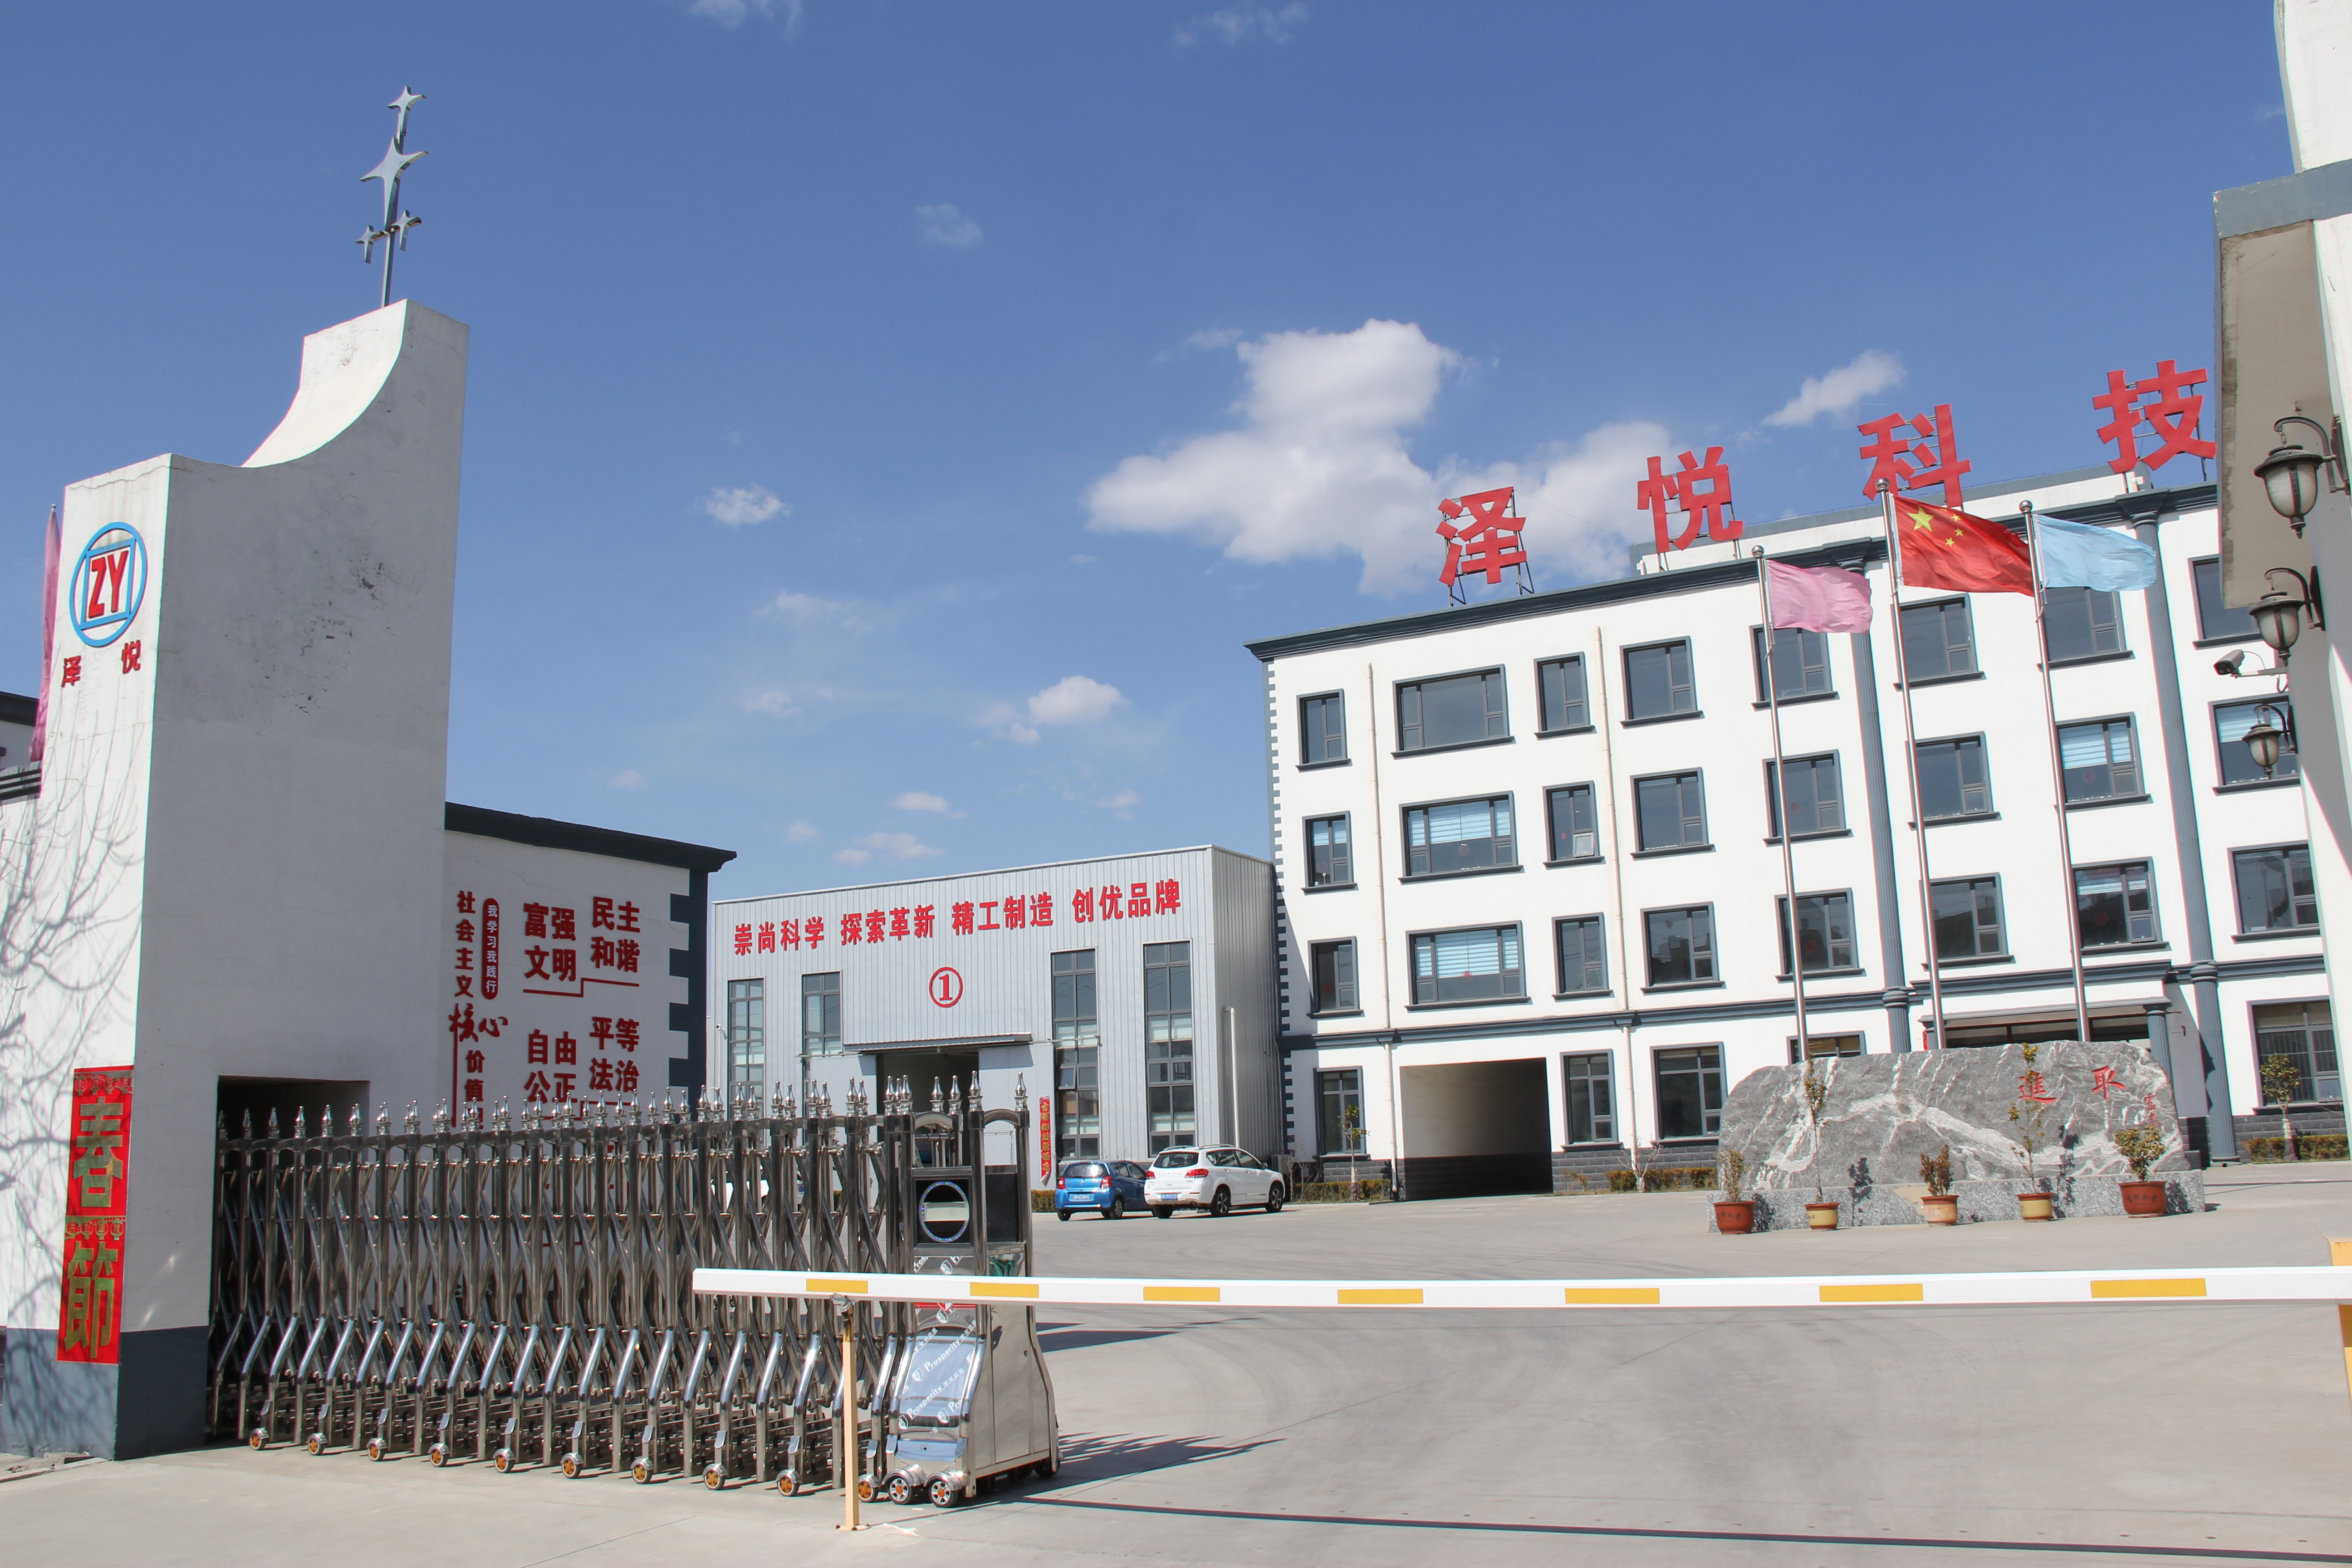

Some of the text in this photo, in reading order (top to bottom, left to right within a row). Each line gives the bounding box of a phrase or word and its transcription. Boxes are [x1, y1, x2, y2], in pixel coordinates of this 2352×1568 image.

[1437, 360, 2216, 585] 泽悦科技
[88, 550, 129, 618] ZY
[62, 640, 142, 687] 泽悦
[524, 902, 576, 941] 富强
[593, 897, 640, 932] 民主
[735, 878, 1181, 955] 崇尚科学 探索革新 精工制造 创优品牌
[456, 891, 475, 997] 社会主义
[485, 904, 498, 993] 我学习我践行
[525, 945, 576, 981] 文明
[592, 936, 640, 972] 和谐
[449, 1003, 509, 1042] 核心
[590, 1017, 640, 1052] 平等
[529, 1029, 576, 1065] 自由
[466, 1050, 485, 1129] 价值
[524, 1071, 578, 1104] 公正
[590, 1058, 640, 1093] 法治
[64, 1096, 123, 1358] 春節
[924, 1338, 960, 1372] Prosperity
[906, 1385, 942, 1419] Prosperity
